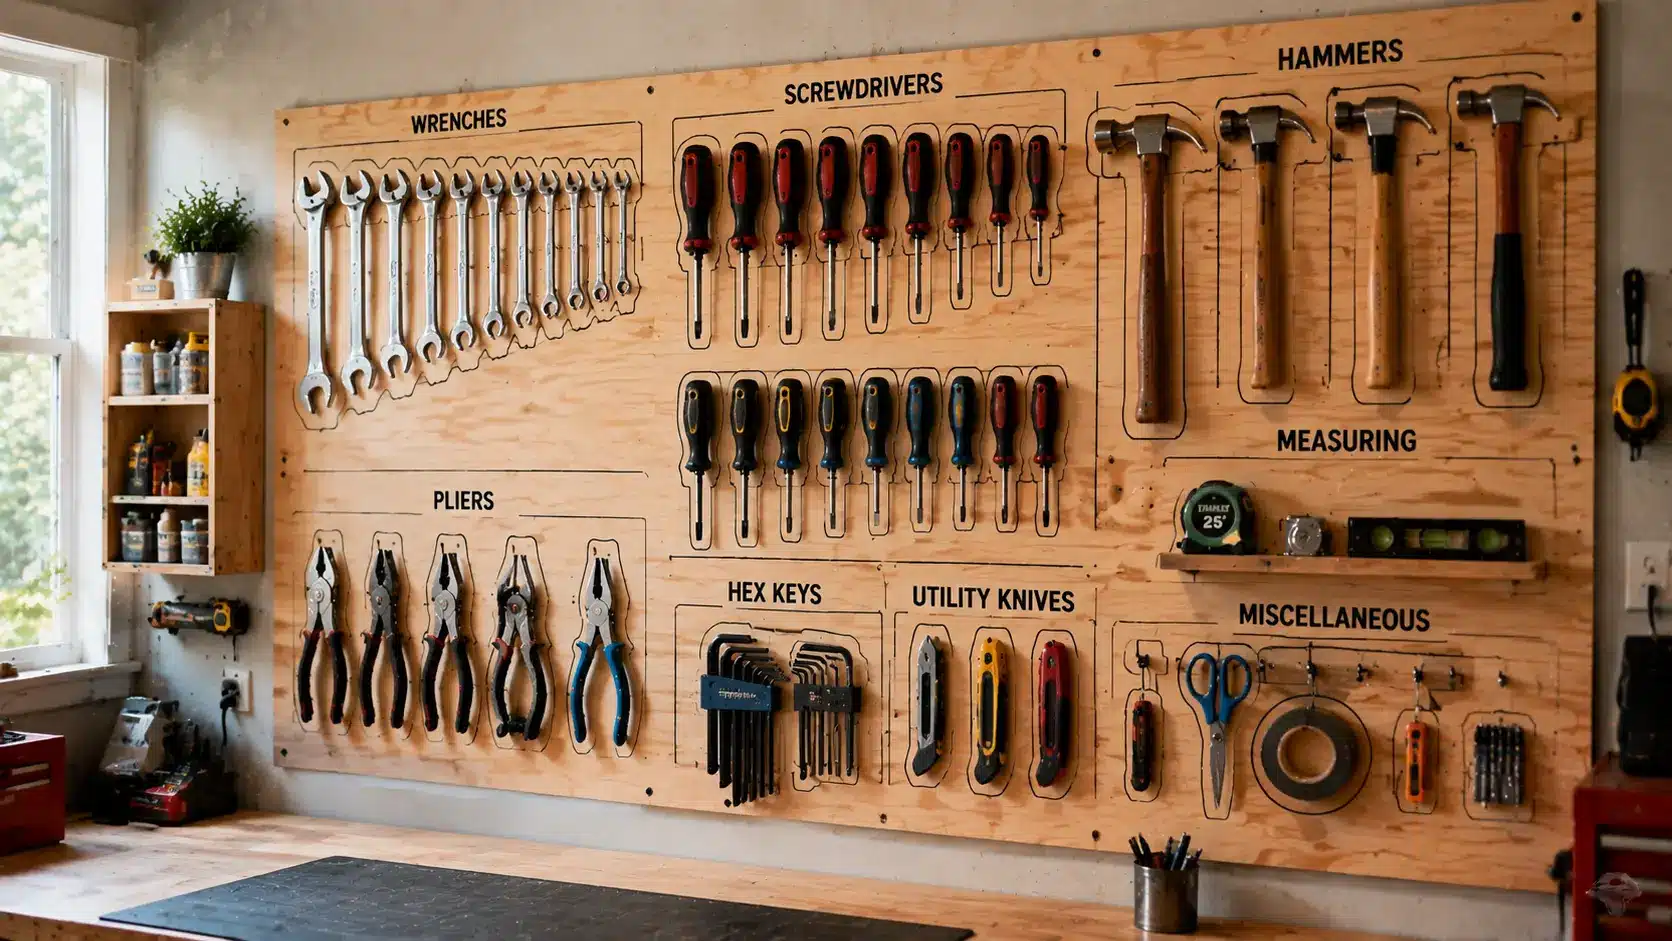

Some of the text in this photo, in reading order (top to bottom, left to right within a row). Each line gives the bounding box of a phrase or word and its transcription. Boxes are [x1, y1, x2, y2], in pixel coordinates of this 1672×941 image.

[1278, 39, 1404, 70] HAMMERS
[784, 71, 944, 105] SCREWDRIVERS
[411, 107, 507, 134] WRENCHES
[1277, 428, 1417, 453] MEASURING
[433, 490, 494, 511] PLIERS
[728, 580, 822, 605] HEX KEYS
[912, 585, 1075, 613] UTILITY KNIVES
[1239, 603, 1431, 632] MISCELLANEOUS
